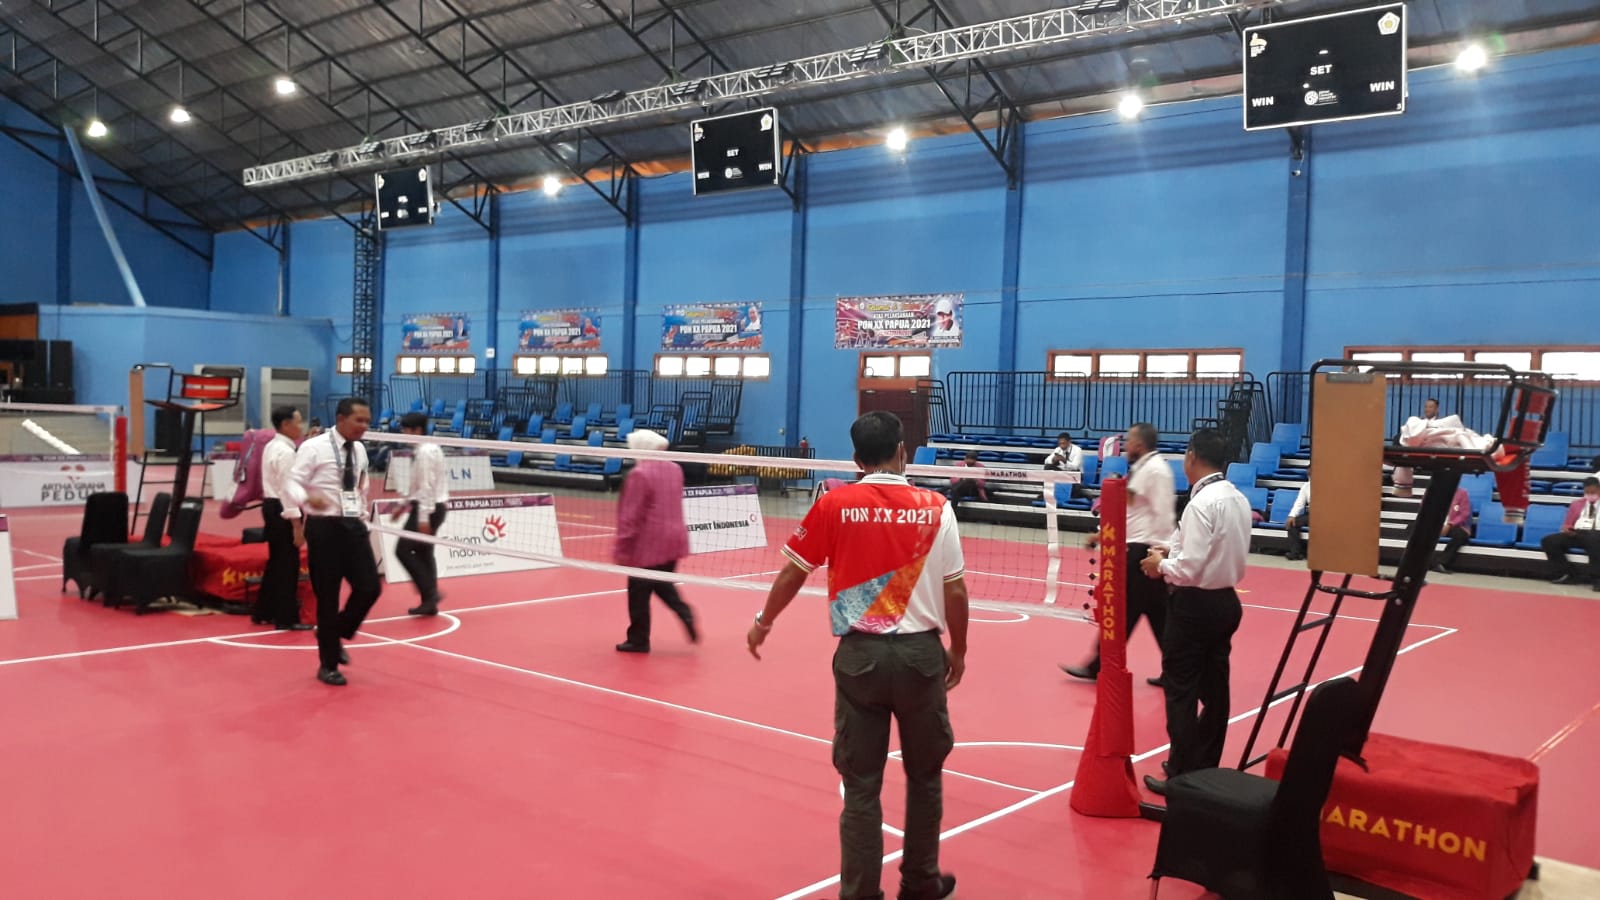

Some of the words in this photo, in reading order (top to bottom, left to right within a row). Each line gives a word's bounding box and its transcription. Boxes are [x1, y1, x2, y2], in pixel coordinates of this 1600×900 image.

[1310, 64, 1332, 76] SET
[1370, 81, 1395, 92] WIN
[1252, 96, 1274, 107] WIN
[727, 148, 739, 157] SET
[722, 324, 737, 333] 2021
[857, 319, 873, 329] PON
[874, 319, 884, 329] XX
[884, 319, 910, 329] PAPUA
[911, 318, 931, 329] 2021
[41, 483, 71, 491] ARTHA
[74, 482, 105, 490] GRAHA
[465, 499, 490, 508] PAPUA
[841, 507, 869, 523] PON
[873, 507, 892, 523] XX
[896, 508, 933, 525] 2021
[1102, 545, 1115, 640] MARATHON
[1320, 804, 1487, 862] ARATHON
